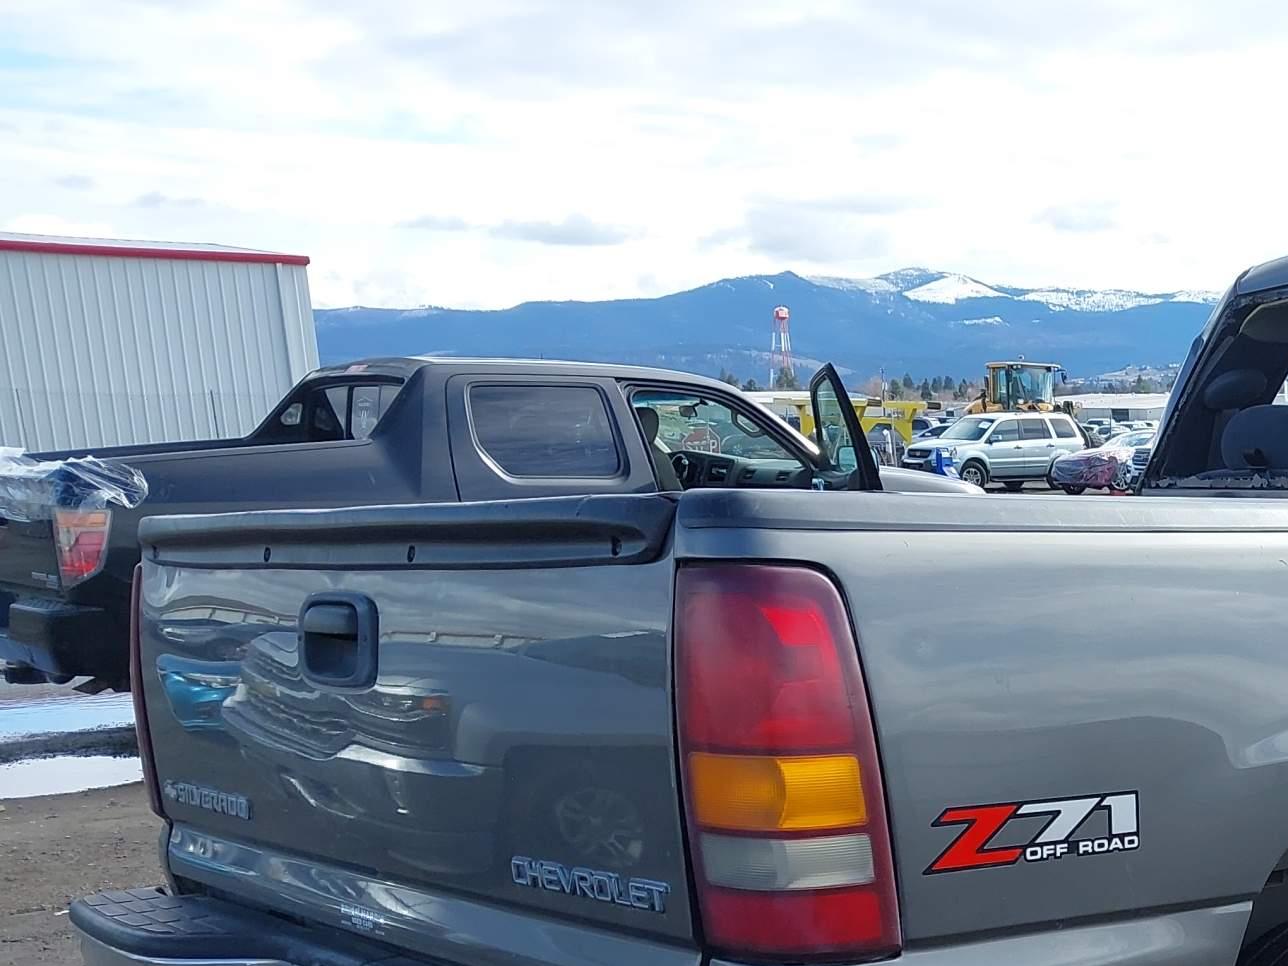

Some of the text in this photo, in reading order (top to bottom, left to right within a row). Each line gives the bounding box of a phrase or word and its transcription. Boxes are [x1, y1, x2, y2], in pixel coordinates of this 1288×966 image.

[921, 790, 1140, 876] Z71
[1025, 834, 1140, 862] OFF ROAD
[511, 855, 671, 912] CHEVROLET
